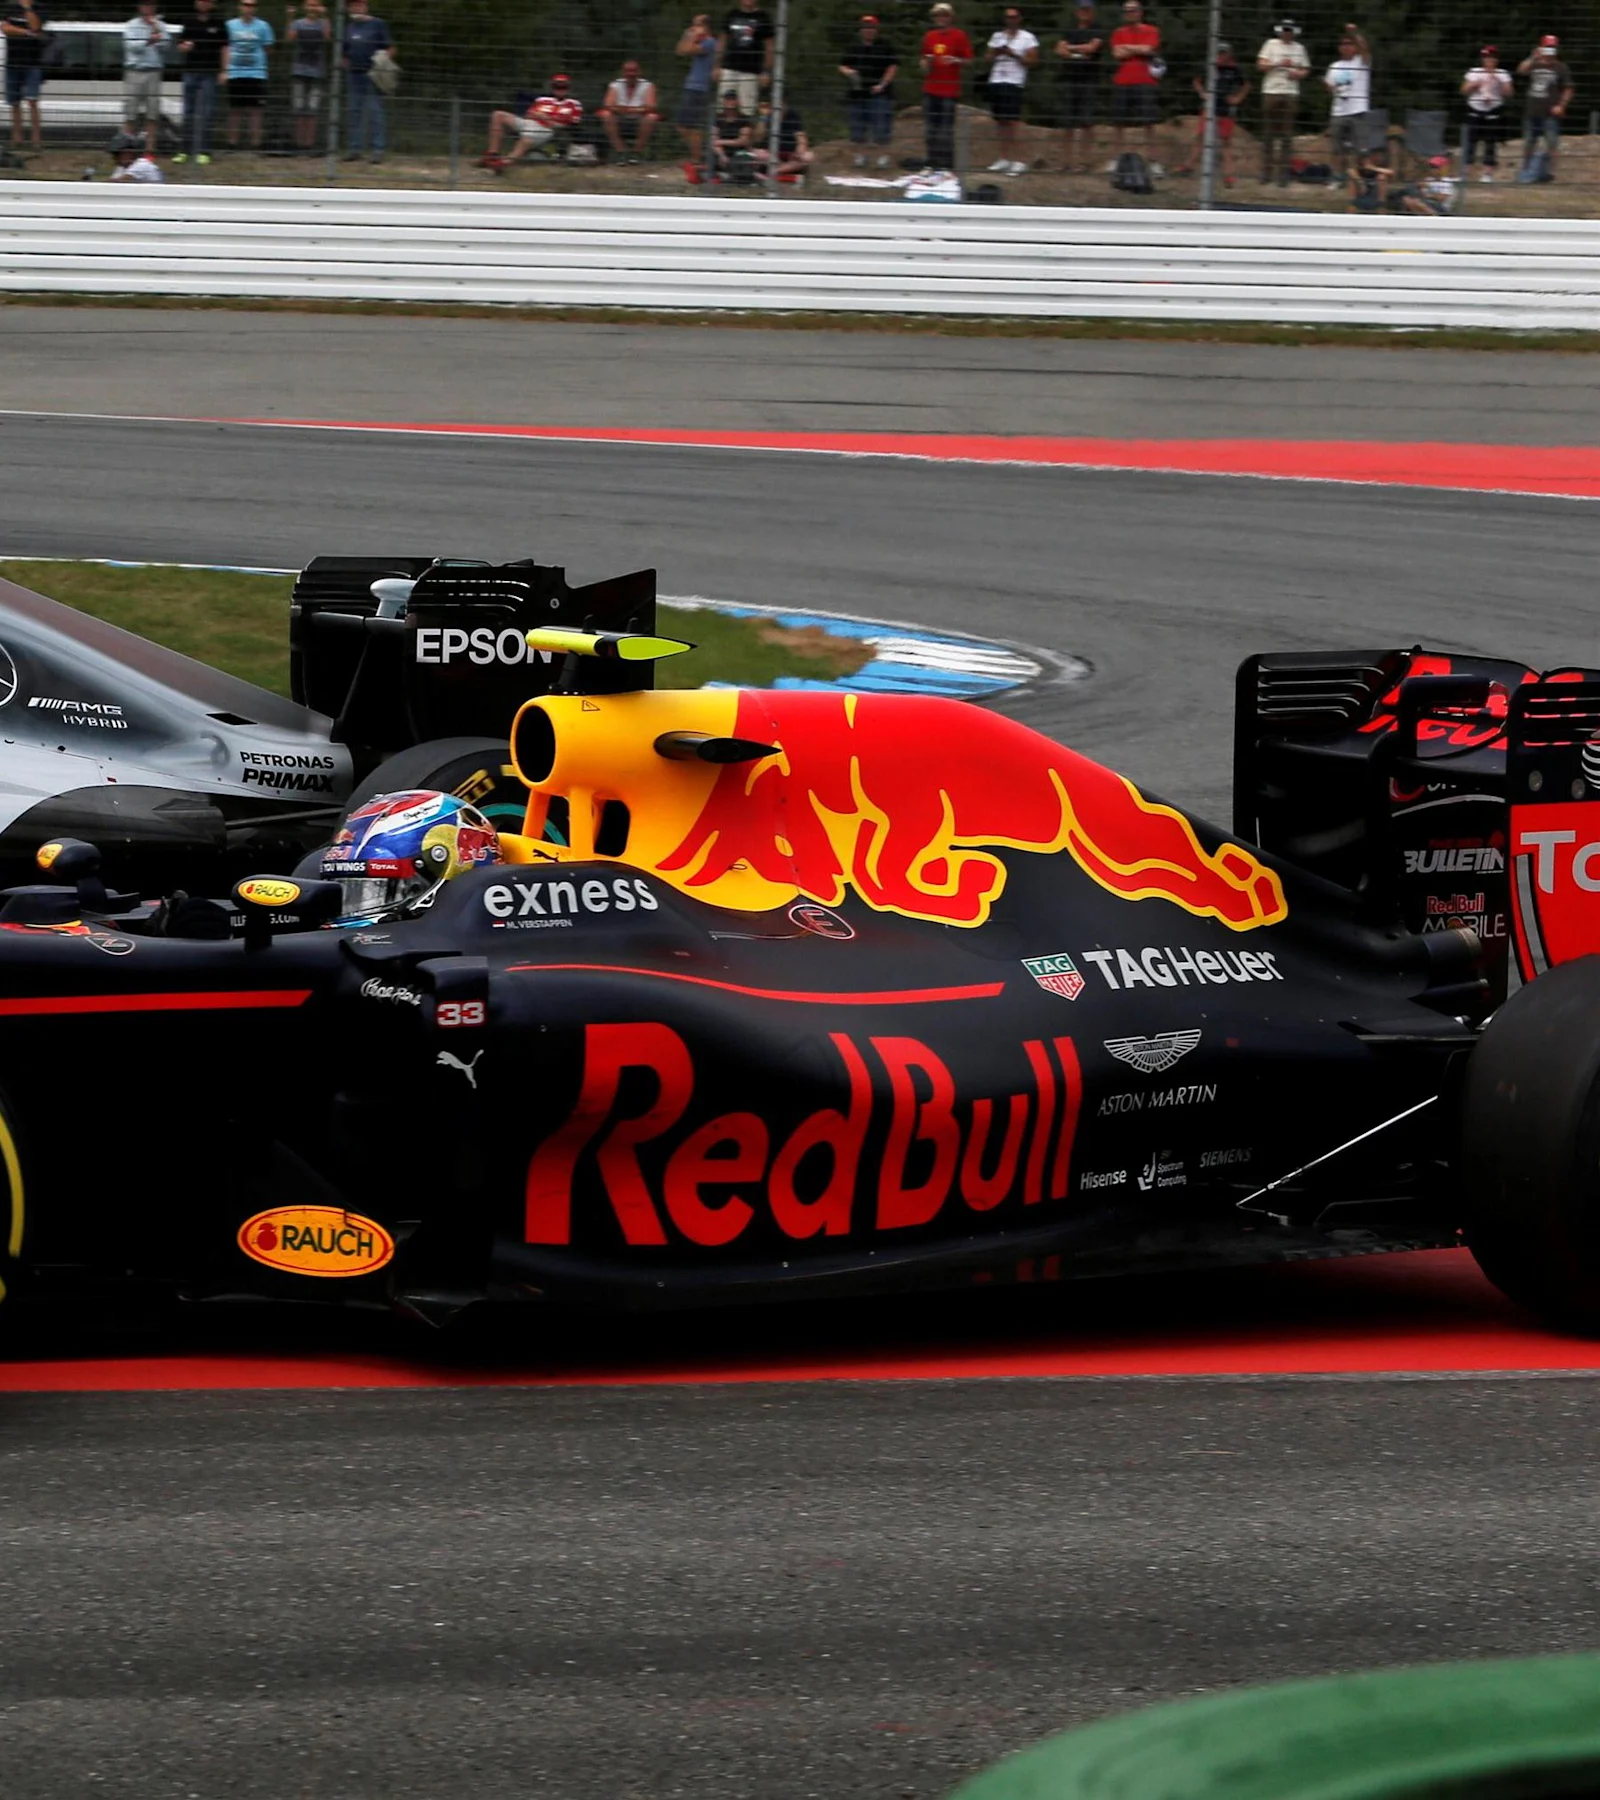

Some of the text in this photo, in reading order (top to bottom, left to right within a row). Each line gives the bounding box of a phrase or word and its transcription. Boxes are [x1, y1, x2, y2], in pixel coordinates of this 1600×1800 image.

[60, 700, 123, 716] AMG
[62, 714, 128, 729] HYBRID
[239, 751, 335, 769] PETRONAS
[242, 768, 334, 793] PRIMAX
[336, 862, 366, 872] WINGS
[370, 863, 399, 871] TOTAL
[253, 883, 292, 898] RAUCH
[483, 878, 659, 918] exness
[1028, 955, 1072, 975] TAG
[1040, 974, 1084, 998] HEUER
[437, 1001, 486, 1026] 33
[1097, 1083, 1218, 1117] ASTON MARTIN
[1200, 1147, 1252, 1169] SIEMENS
[1080, 1169, 1127, 1191] Hisense
[281, 1223, 374, 1259] RAUCH
